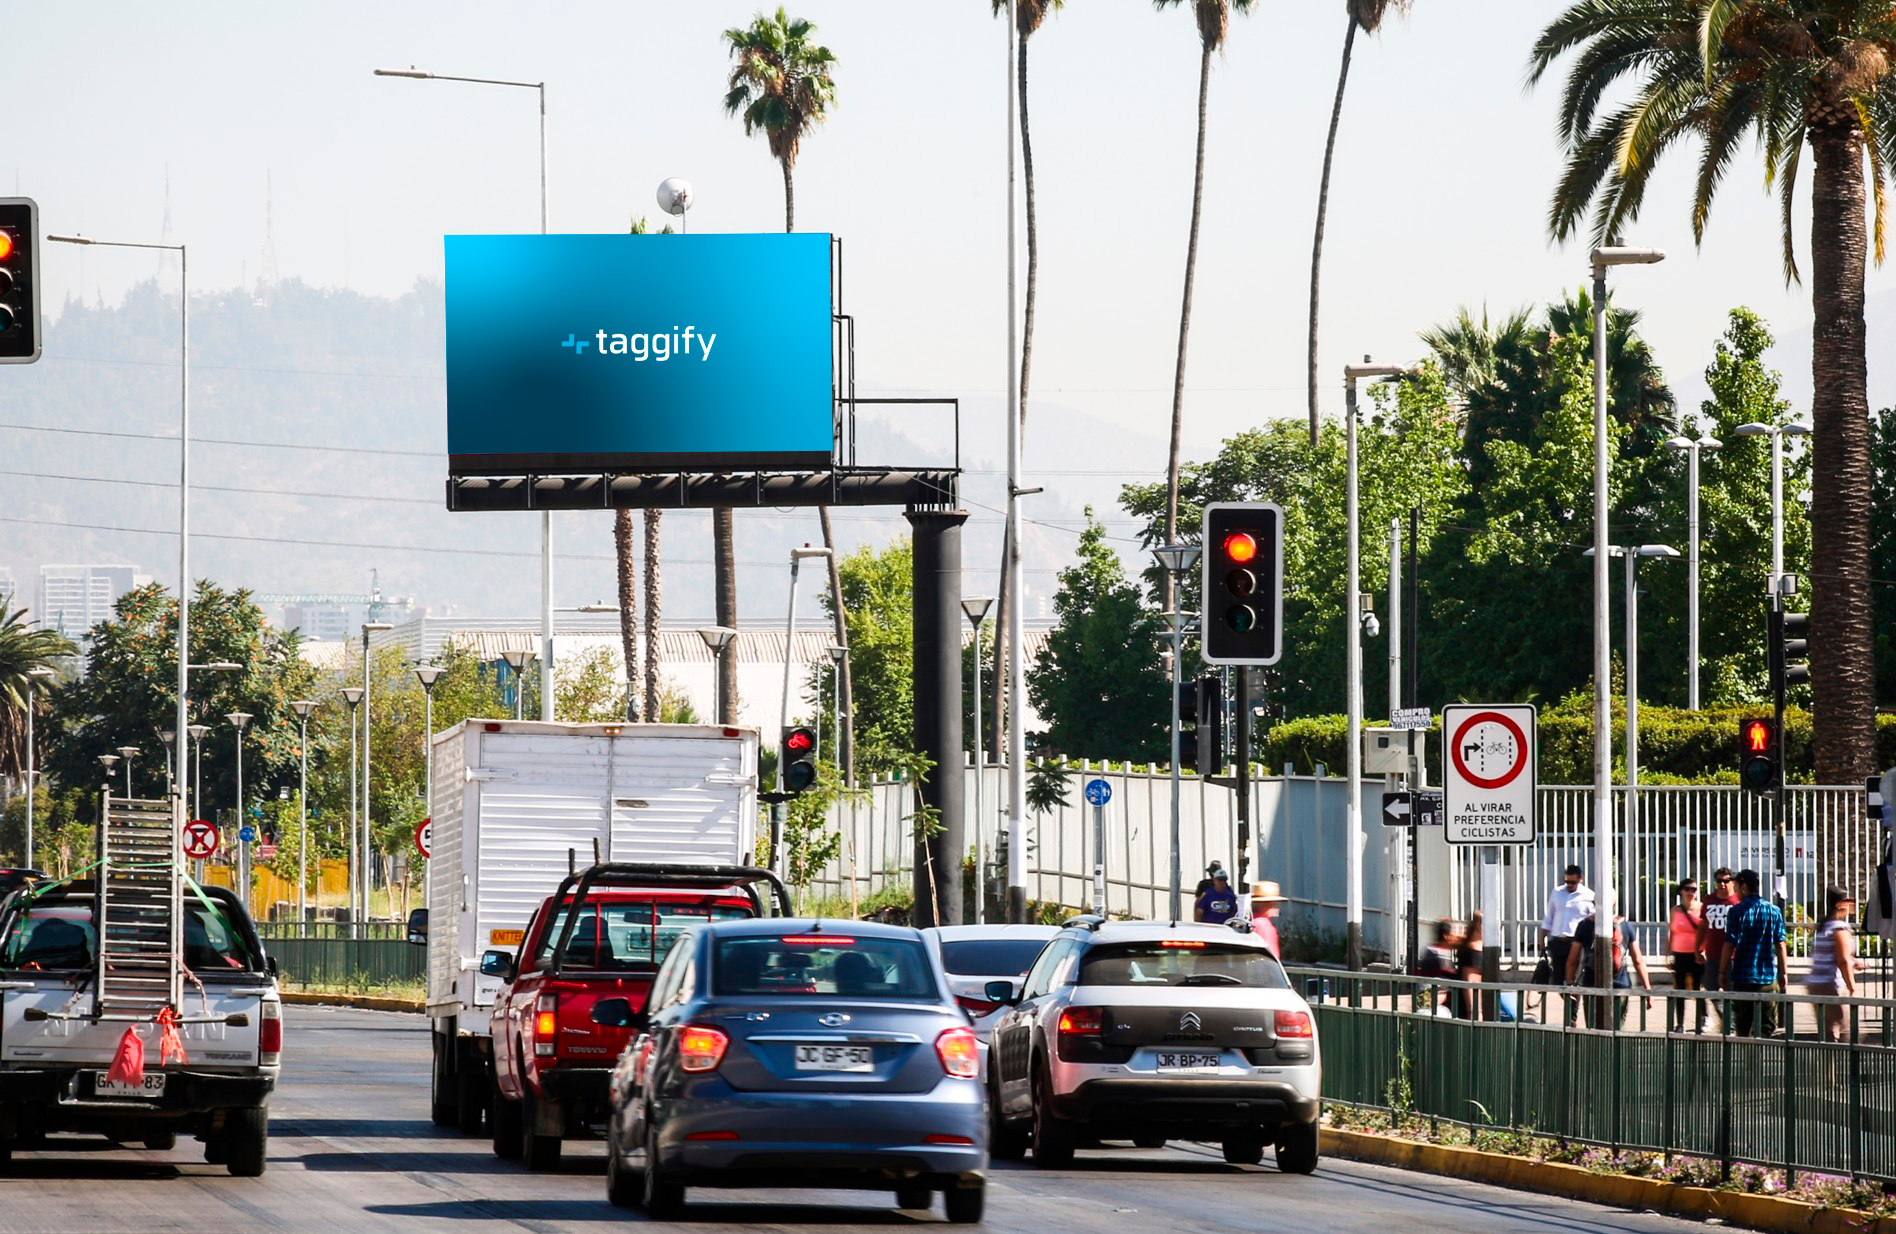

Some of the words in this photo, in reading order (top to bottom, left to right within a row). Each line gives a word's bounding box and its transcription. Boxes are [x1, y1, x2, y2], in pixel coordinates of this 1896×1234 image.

[595, 325, 717, 362] taggify
[1392, 707, 1430, 717] COMPRO
[1464, 803, 1478, 812] AL
[1480, 803, 1512, 812] VIRAR
[1454, 815, 1526, 825] PREFERENCIA
[1461, 828, 1516, 837] CICLISTAS
